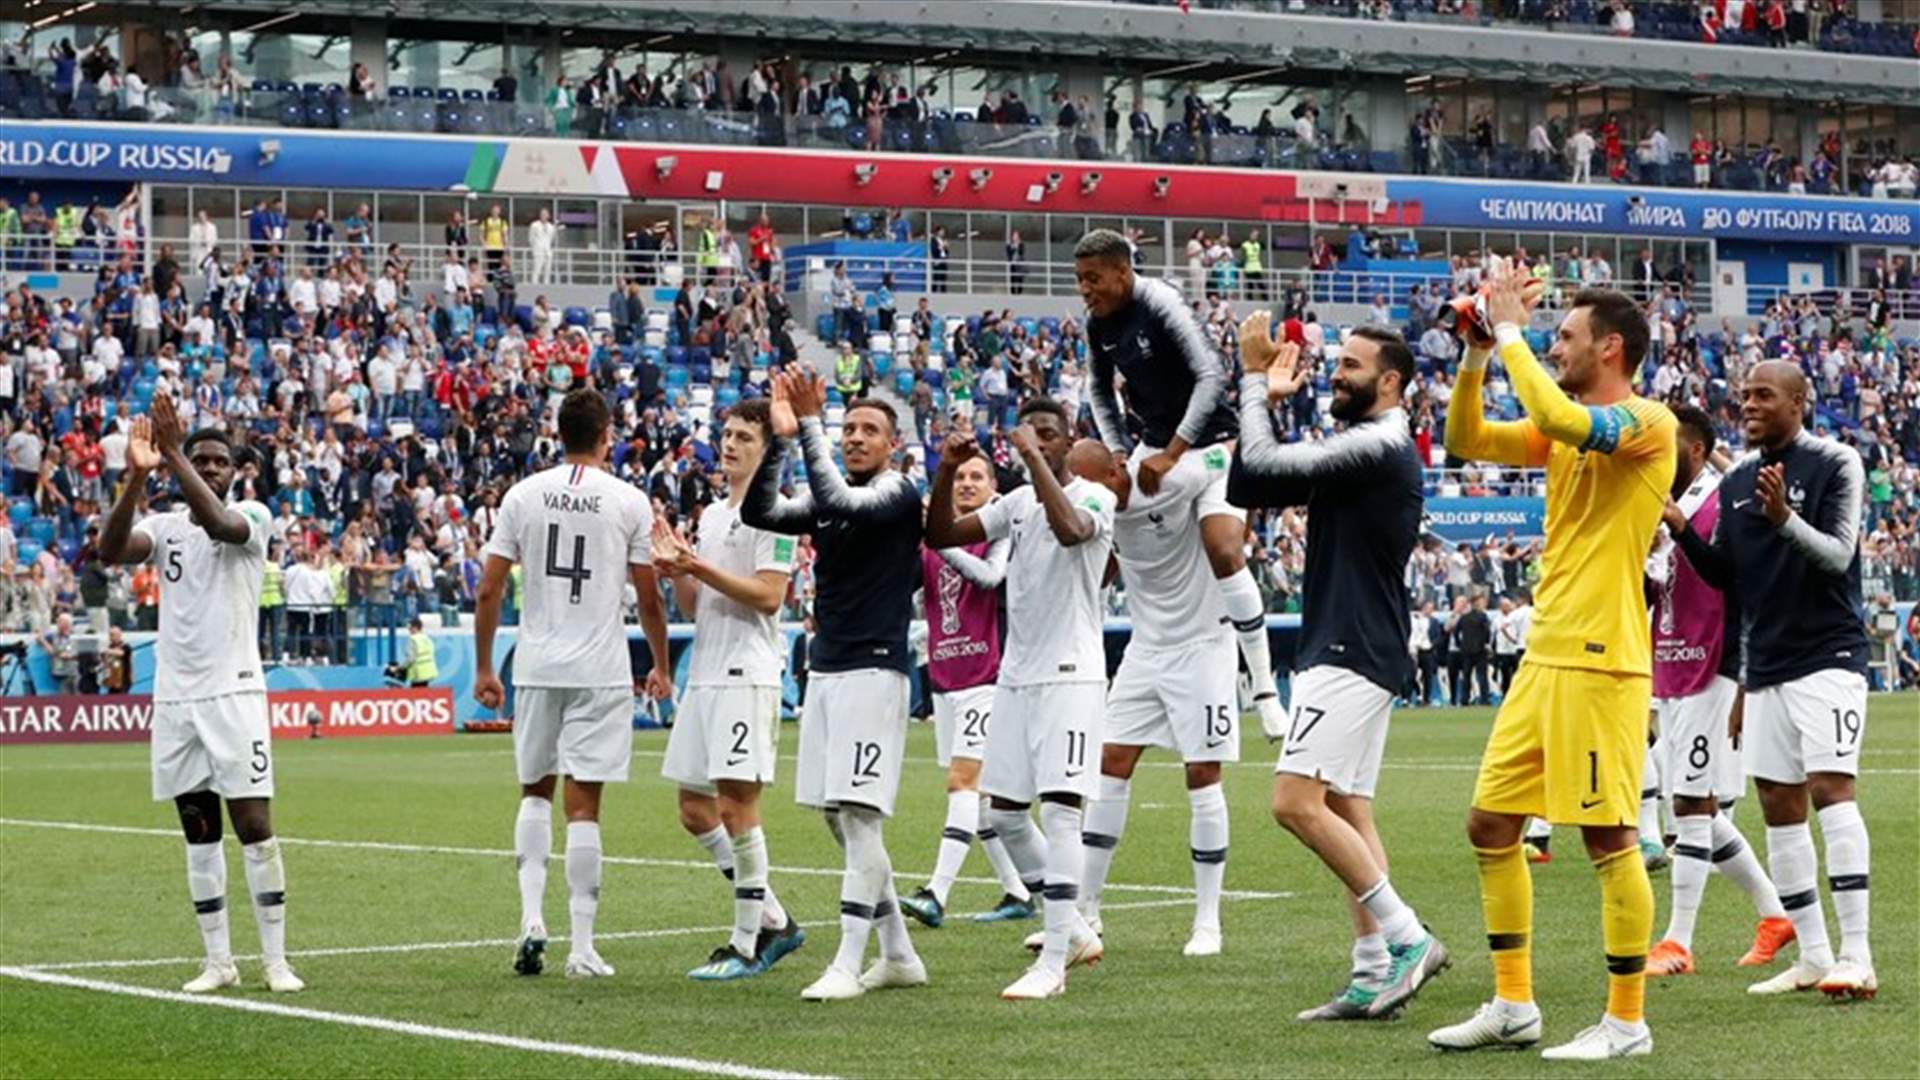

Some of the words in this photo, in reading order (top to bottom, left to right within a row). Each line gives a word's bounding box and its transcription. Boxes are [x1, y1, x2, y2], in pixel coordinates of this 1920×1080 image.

[50, 140, 111, 167] CUP
[119, 144, 219, 170] RUSSIA
[1481, 197, 1605, 224] ЧЕМПИОНАТ
[1736, 208, 1823, 230] ФУТБОЛУ
[1827, 210, 1866, 233] FIFA
[1870, 213, 1911, 235] 2018
[543, 492, 602, 513] VARANE
[1456, 511, 1481, 524] CUP
[1483, 511, 1527, 525] RUSSIA
[165, 551, 183, 582] 5
[546, 523, 591, 604] 4
[1670, 646, 1706, 661] 2018
[0, 707, 62, 732] TAR
[271, 702, 319, 727] KIA
[330, 698, 450, 727] MOTORS
[1205, 705, 1232, 736] 15
[1288, 706, 1326, 742] 17
[1831, 708, 1861, 745] 19
[731, 721, 749, 754] 2
[1067, 730, 1086, 766] 11
[1689, 735, 1710, 769] 8
[251, 741, 268, 773] 5
[854, 741, 882, 777] 12
[1589, 751, 1598, 794] 1
